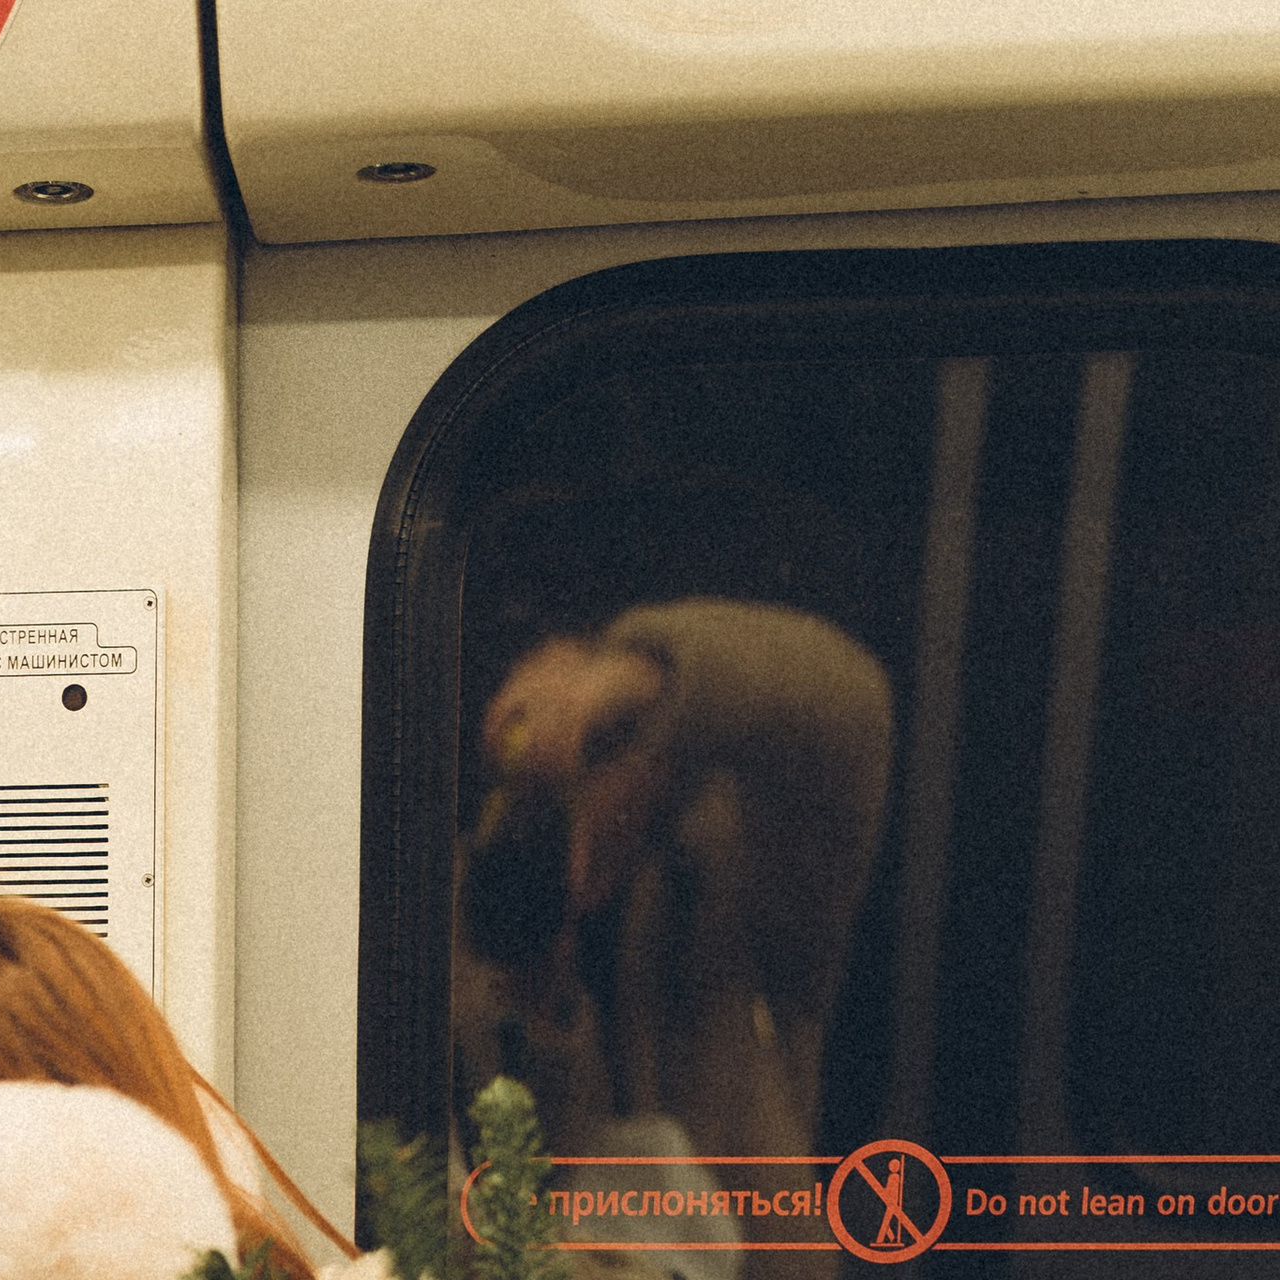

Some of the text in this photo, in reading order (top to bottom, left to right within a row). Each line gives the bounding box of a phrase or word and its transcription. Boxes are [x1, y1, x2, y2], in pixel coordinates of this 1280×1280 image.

[8, 653, 122, 670] МАШИНИСТОМ
[549, 1182, 823, 1226] прислоняться!
[966, 1186, 1278, 1216] Do not lean on door
